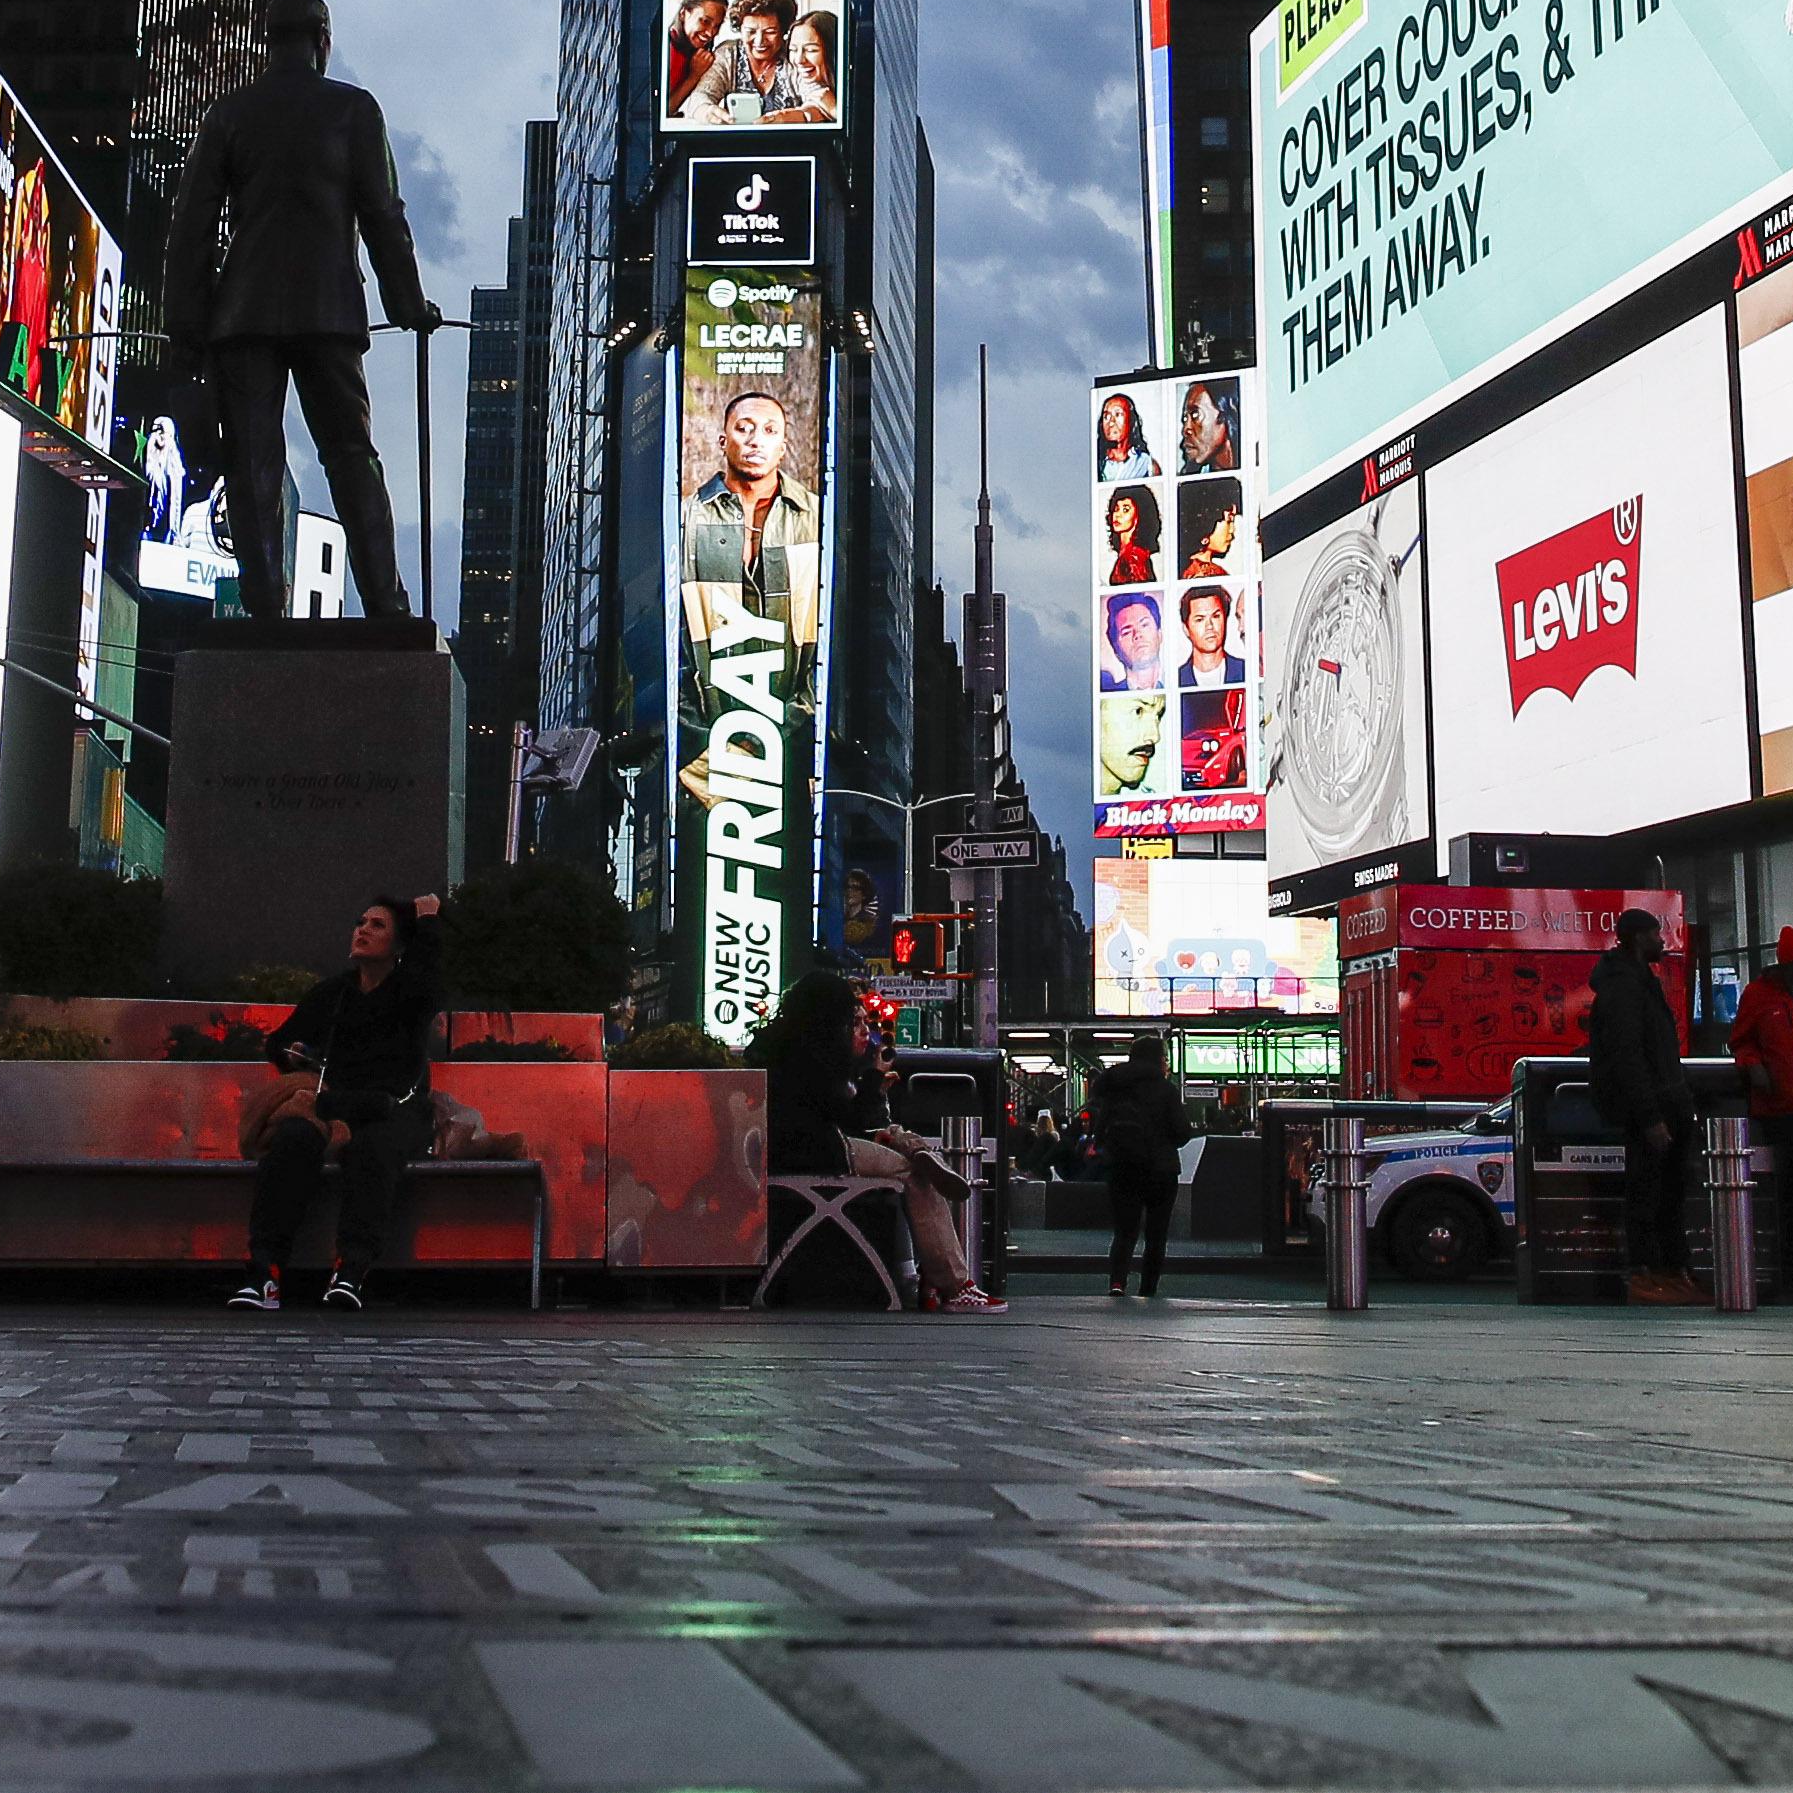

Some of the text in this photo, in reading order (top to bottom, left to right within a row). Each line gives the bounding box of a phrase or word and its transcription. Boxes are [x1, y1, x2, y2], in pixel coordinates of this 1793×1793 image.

[1279, 49, 1389, 208] COVER
[1279, 174, 1361, 303] WITH
[1367, 44, 1535, 237] TISSUES,
[722, 213, 780, 230] TikTok
[738, 284, 798, 304] Spotify
[1282, 169, 1493, 394] THEM AWAY.
[699, 323, 803, 348] LECRAE
[1377, 432, 1417, 467] MARRIOTT
[1378, 456, 1413, 489] MARQUIS
[706, 590, 786, 902] FRIDAY
[1105, 797, 1260, 828] Black Monday
[950, 842, 1025, 859] ONE WAY
[1354, 863, 1393, 888] SWISS MADE
[1408, 906, 1529, 933] COFFEED
[714, 911, 741, 995] NEW
[1415, 1145, 1459, 1159] POLICE
